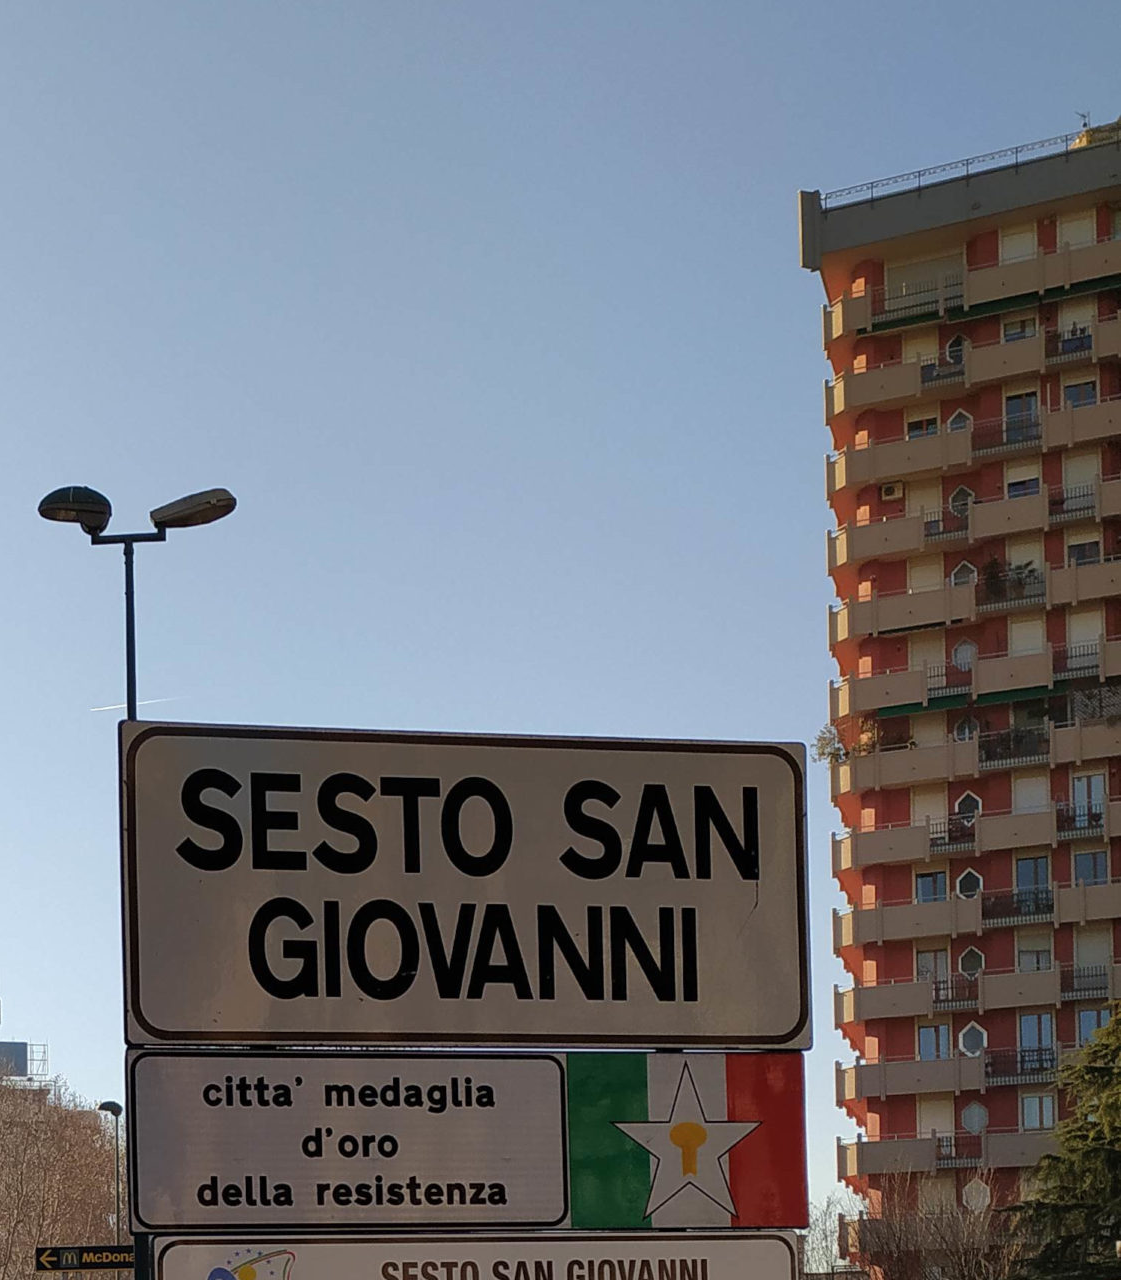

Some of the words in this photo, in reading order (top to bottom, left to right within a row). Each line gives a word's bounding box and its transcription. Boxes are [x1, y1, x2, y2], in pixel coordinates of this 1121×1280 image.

[175, 767, 514, 878] SESTO
[559, 779, 760, 881] SAN
[248, 896, 699, 1002] GIOVANNI
[202, 1075, 303, 1107] citta'
[324, 1076, 496, 1113] medaglia
[301, 1127, 399, 1158] d'oro
[196, 1175, 294, 1207] della
[316, 1174, 508, 1207] resistenza
